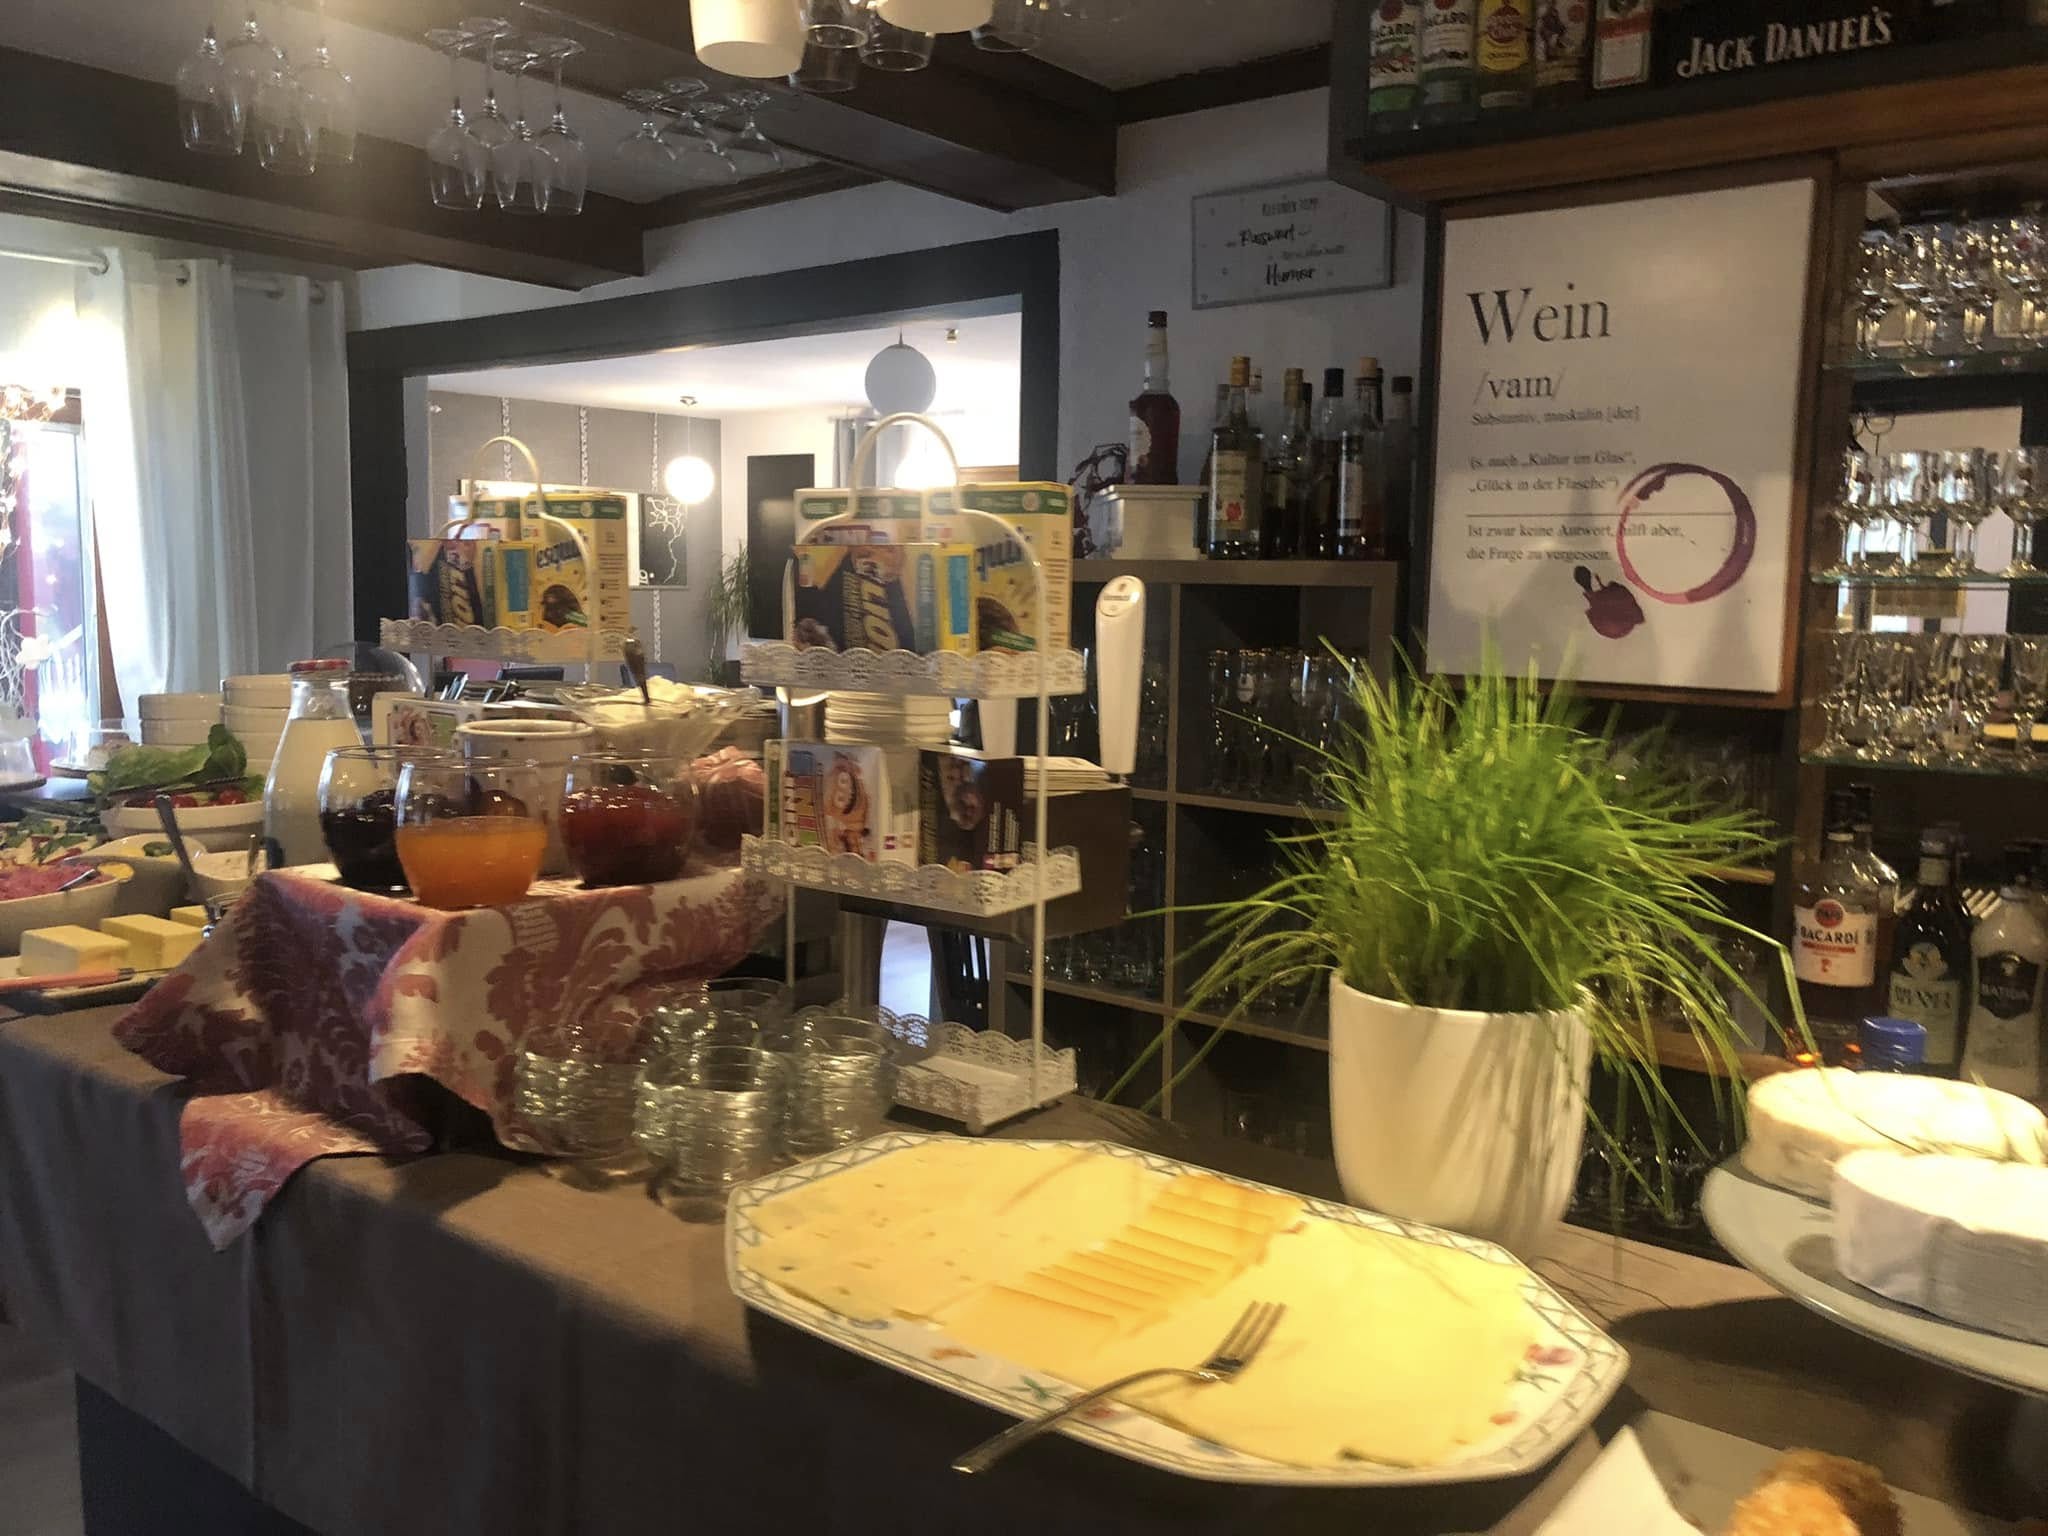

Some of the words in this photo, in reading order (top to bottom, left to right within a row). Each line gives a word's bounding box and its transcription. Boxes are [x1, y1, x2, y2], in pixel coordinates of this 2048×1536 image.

[1675, 34, 1758, 79] JACK
[1764, 5, 1894, 65] DANIEL'S
[1466, 282, 1612, 347] Wein
[1516, 479, 1529, 490] in
[1532, 477, 1553, 490] der
[1468, 523, 1483, 537] Ist
[1486, 525, 1516, 537] zwar
[1519, 522, 1553, 537] keine
[1466, 548, 1486, 560] die
[1489, 547, 1524, 563] Frage
[1527, 550, 1543, 560] zu
